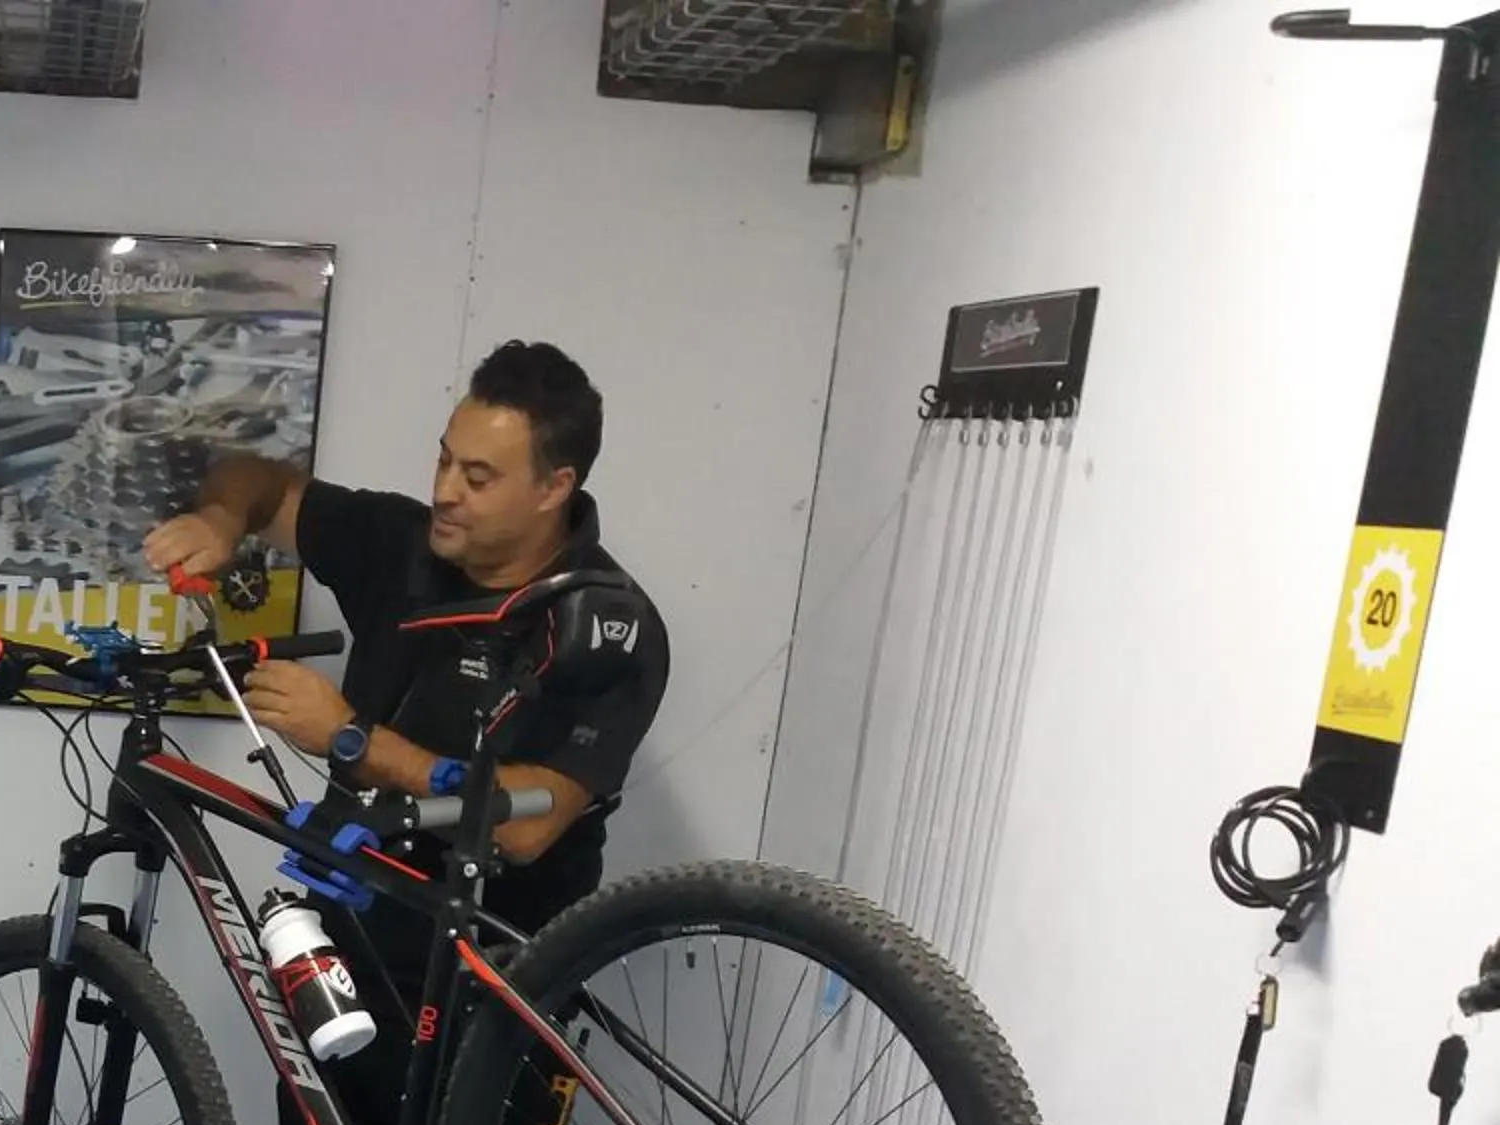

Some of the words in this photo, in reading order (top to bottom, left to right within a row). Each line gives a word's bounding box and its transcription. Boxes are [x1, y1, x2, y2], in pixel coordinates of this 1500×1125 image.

[16, 259, 205, 307] Bikefriendly
[1366, 588, 1398, 628] 20
[195, 876, 326, 1092] MERIDA
